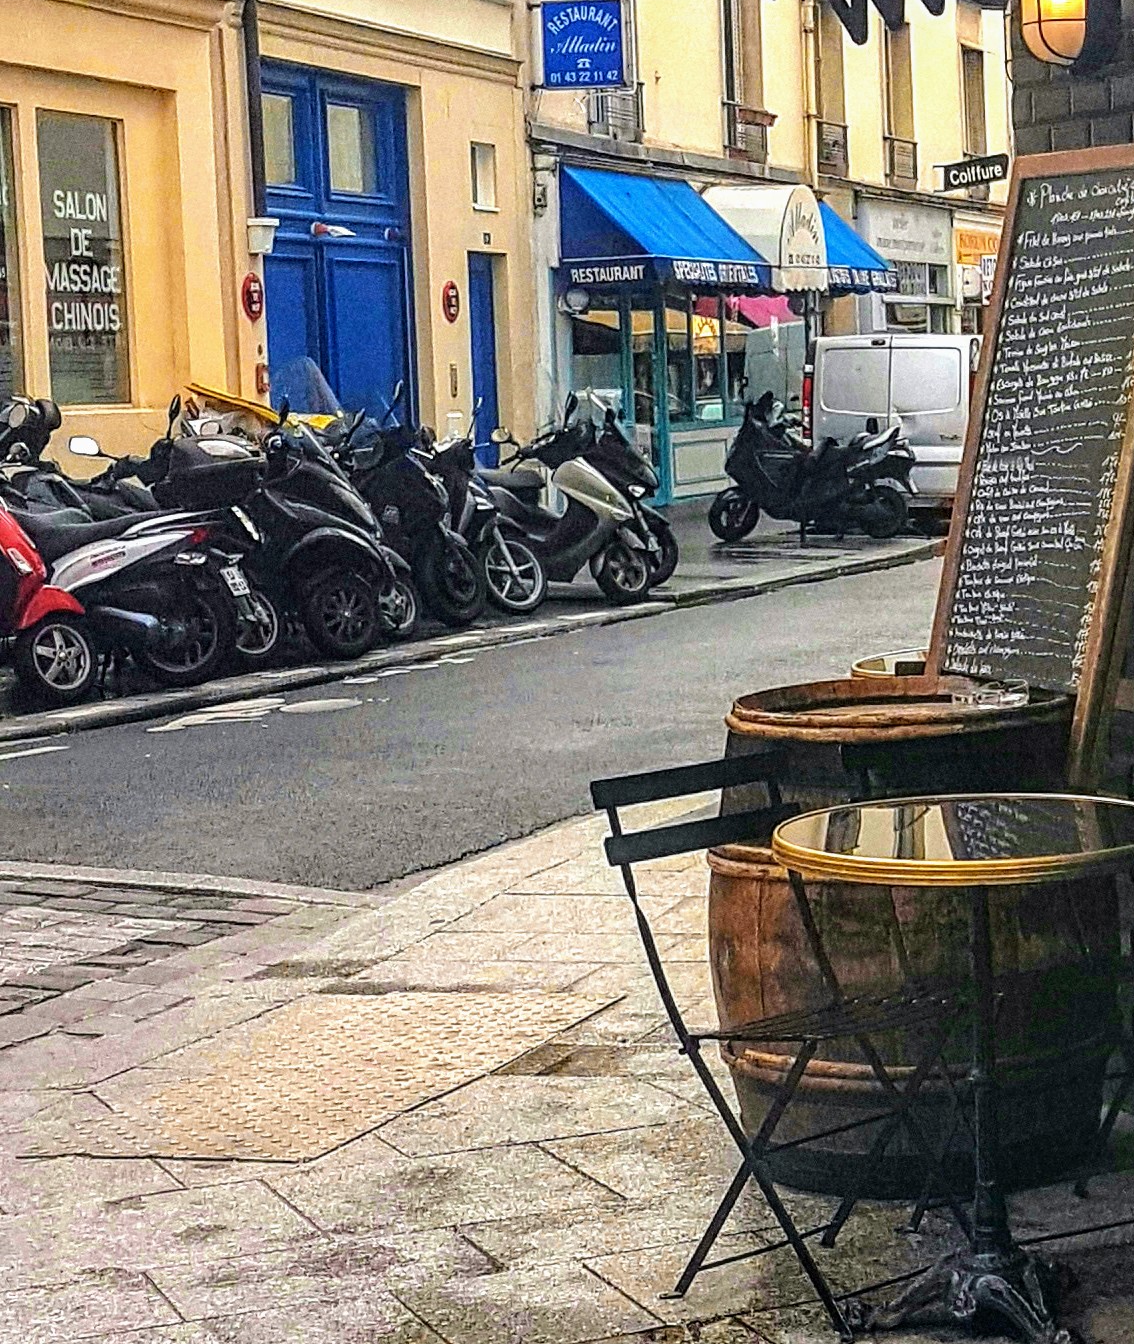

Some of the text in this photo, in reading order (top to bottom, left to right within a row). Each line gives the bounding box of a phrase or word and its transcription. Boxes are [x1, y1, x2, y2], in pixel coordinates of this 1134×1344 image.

[547, 6, 618, 35] RESTAURANT
[551, 70, 618, 83] 01 43 22 11 42
[949, 164, 1003, 185] Coiffure
[53, 190, 107, 222] SALON
[70, 228, 93, 257] DE
[45, 262, 121, 293] MASSAGE
[570, 264, 645, 283] RESTAURANT
[52, 303, 121, 331] CHINOIS
